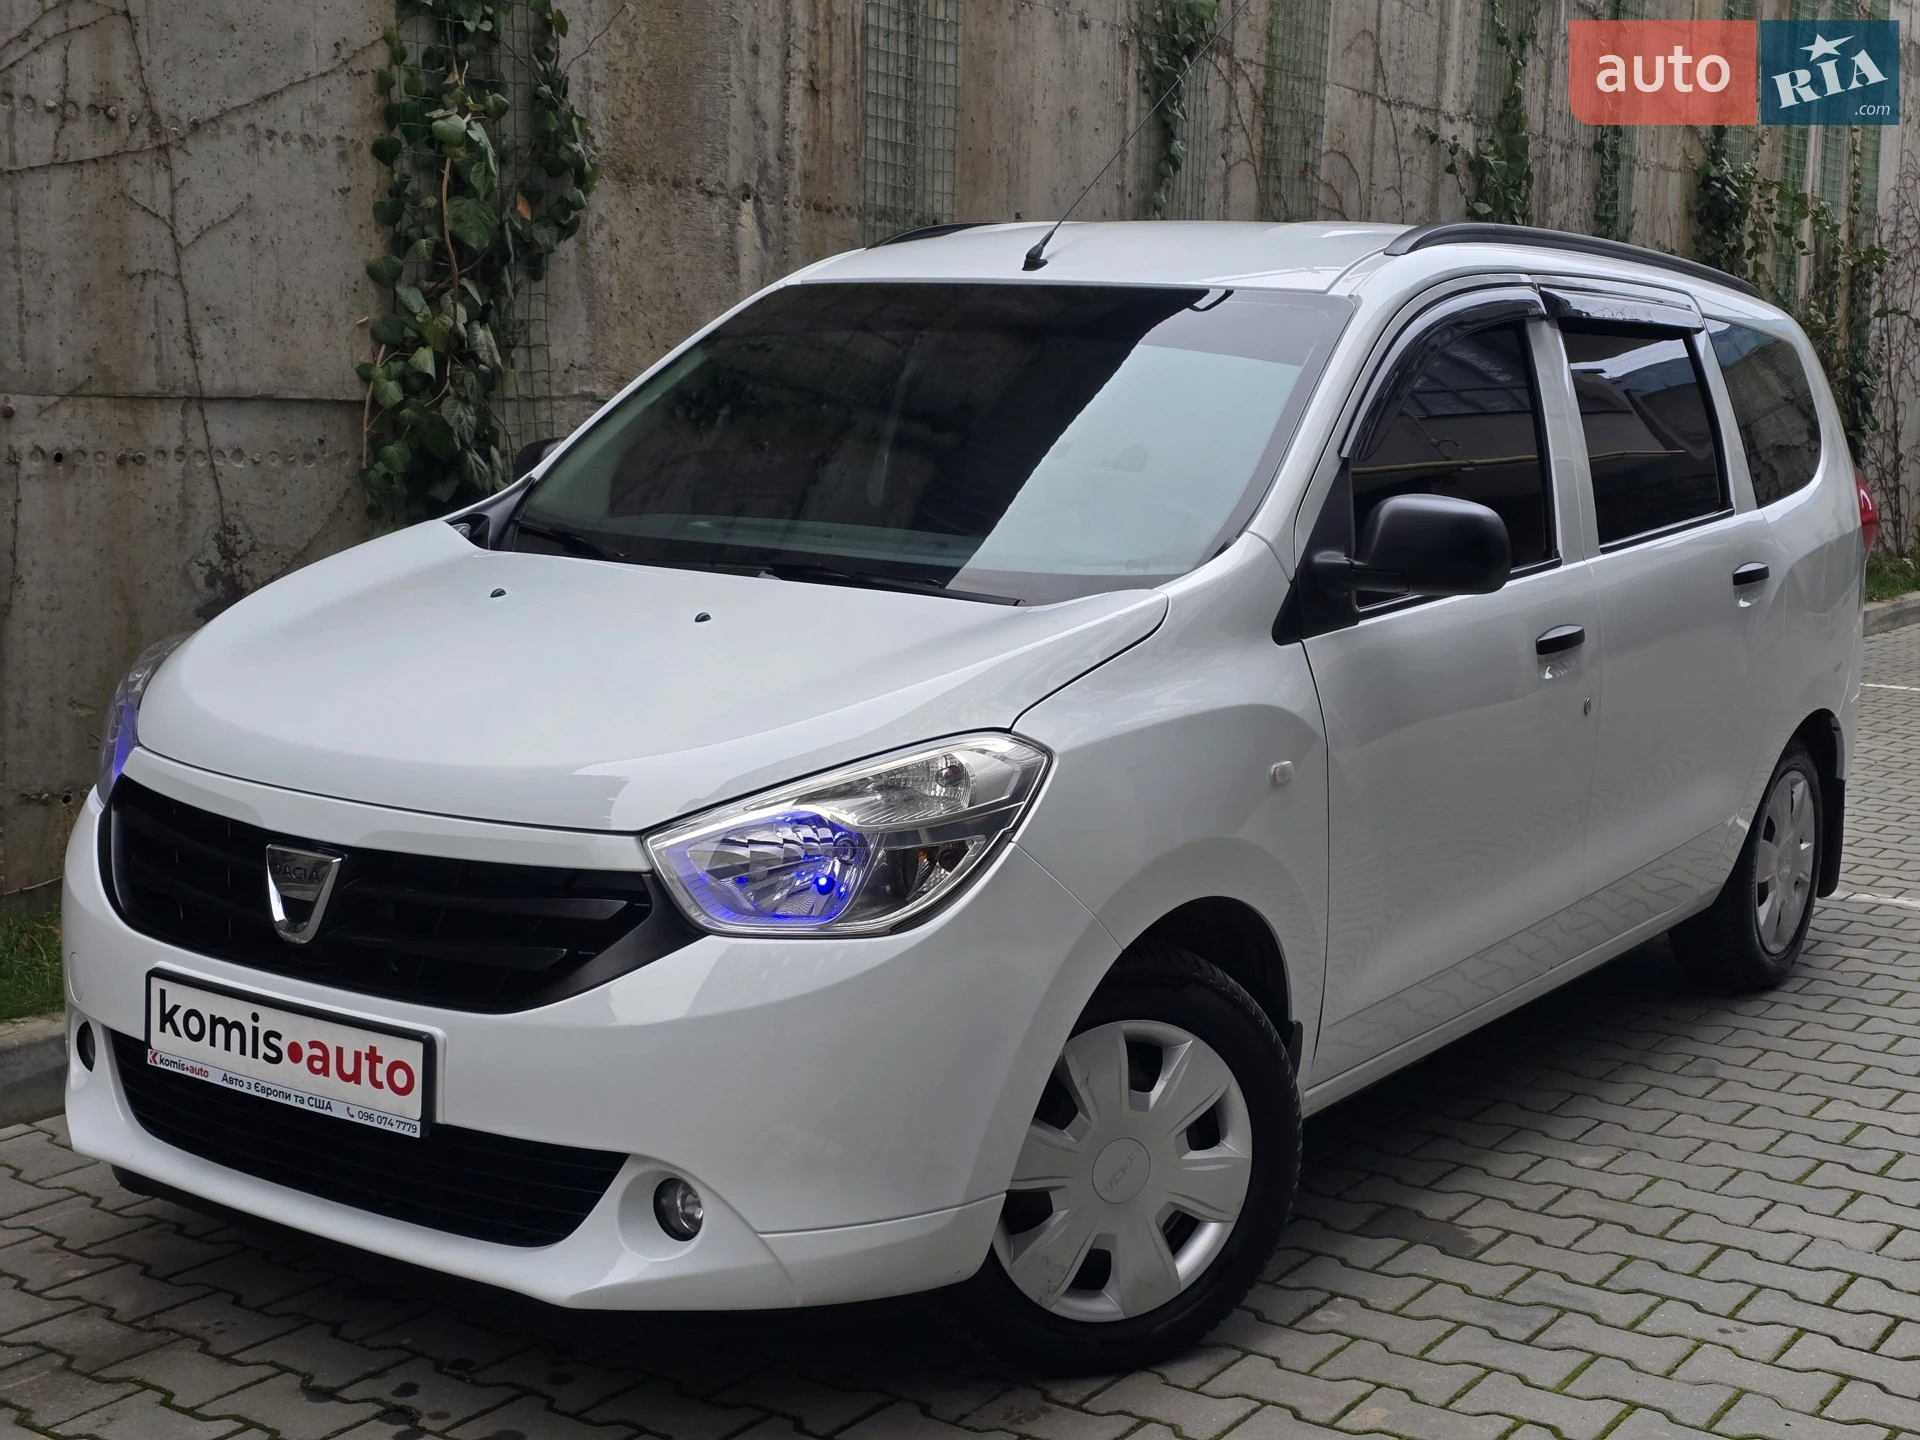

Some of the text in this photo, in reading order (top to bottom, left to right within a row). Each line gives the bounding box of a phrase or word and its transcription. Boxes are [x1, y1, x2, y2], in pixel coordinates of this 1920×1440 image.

[273, 864, 319, 884] DACIA
[221, 1073, 333, 1113] Авто з Європи та США
[357, 1110, 418, 1134] 096 074 7779
